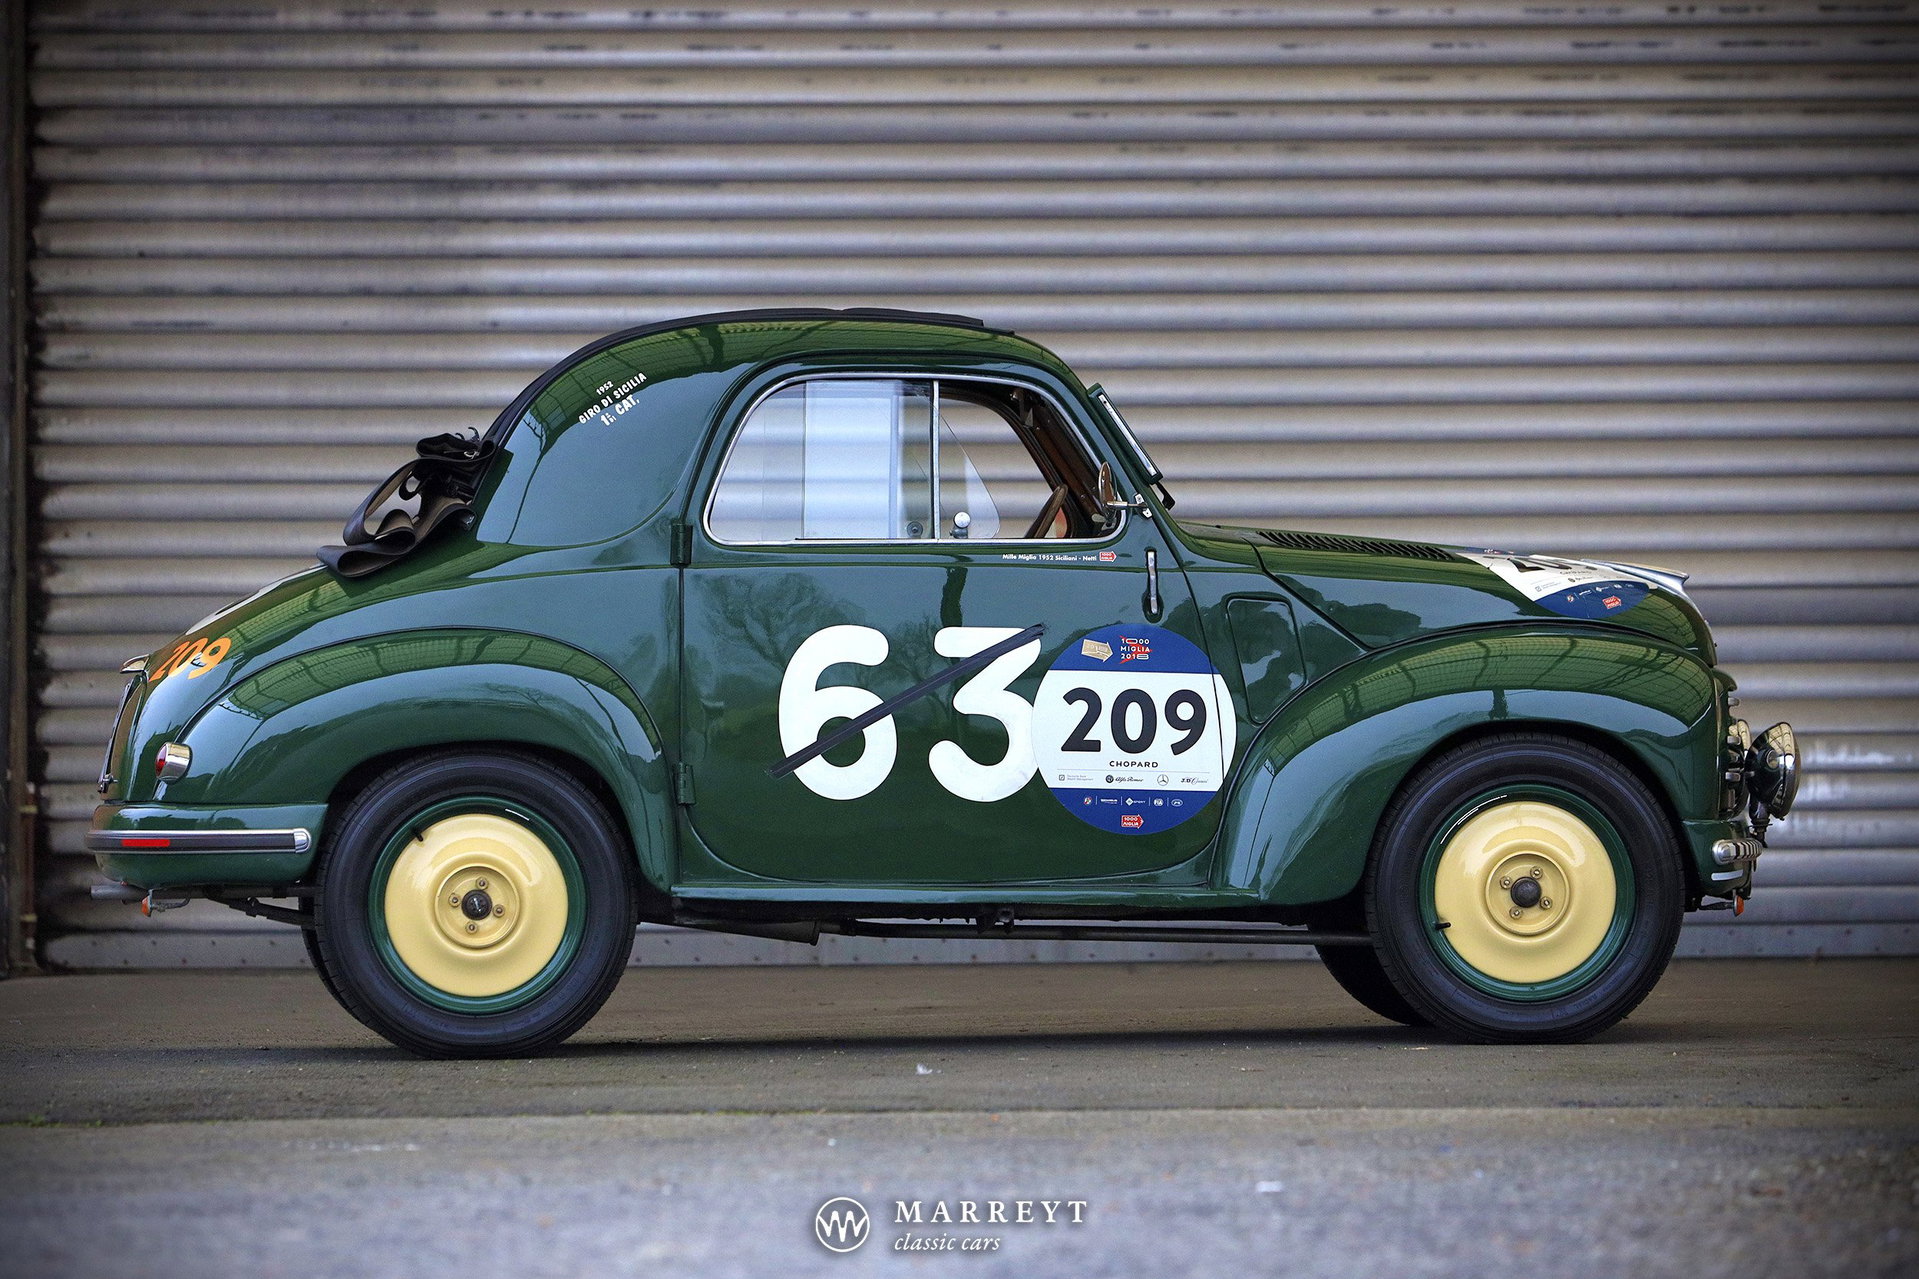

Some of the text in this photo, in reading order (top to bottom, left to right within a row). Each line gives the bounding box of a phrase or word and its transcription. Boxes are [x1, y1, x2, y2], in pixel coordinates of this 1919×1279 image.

[578, 372, 647, 424] GIRO DI SICILIA
[596, 381, 614, 396] 1952
[1018, 553, 1037, 562] Miglia
[148, 637, 232, 682] 209
[778, 624, 1042, 803] 63
[1061, 687, 1207, 756] 209
[1109, 760, 1159, 768] CHOPARD
